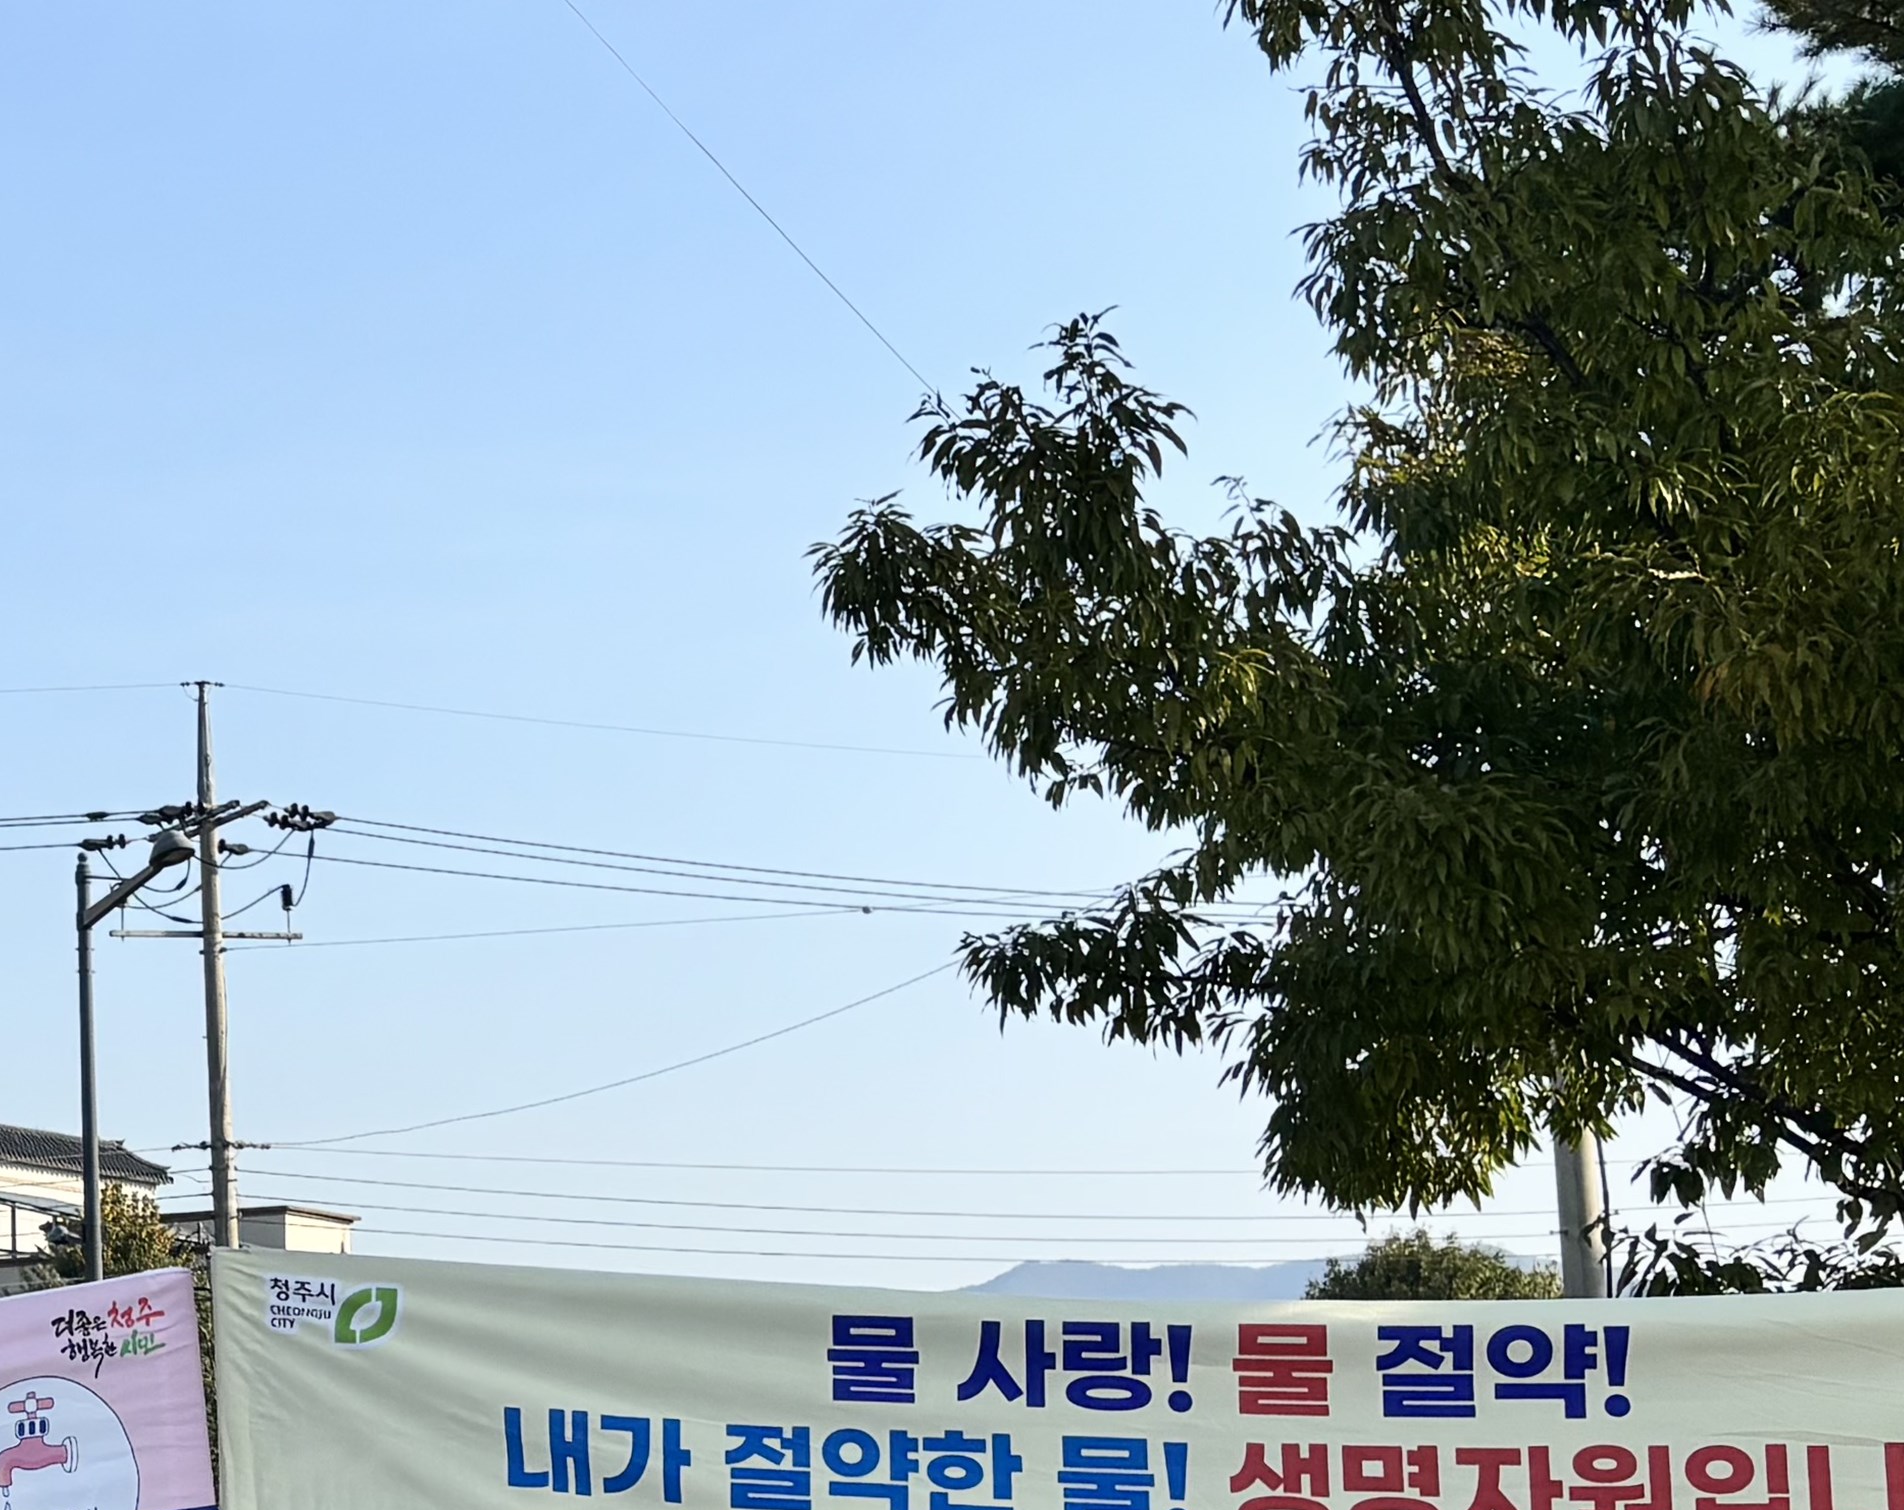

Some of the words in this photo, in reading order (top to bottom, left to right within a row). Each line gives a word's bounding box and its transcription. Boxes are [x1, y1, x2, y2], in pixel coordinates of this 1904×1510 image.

[270, 1277, 335, 1306] 청주시
[51, 1309, 106, 1338] 더좋은
[107, 1297, 164, 1328] 청주
[271, 1317, 295, 1329] CITY
[61, 1333, 117, 1378] 행복한
[119, 1329, 166, 1357] 시민
[827, 1314, 920, 1404] 물
[956, 1318, 1194, 1413] 사랑!
[1233, 1323, 1333, 1417] 물
[1375, 1323, 1631, 1419] 절약!
[504, 1406, 693, 1506] 내가
